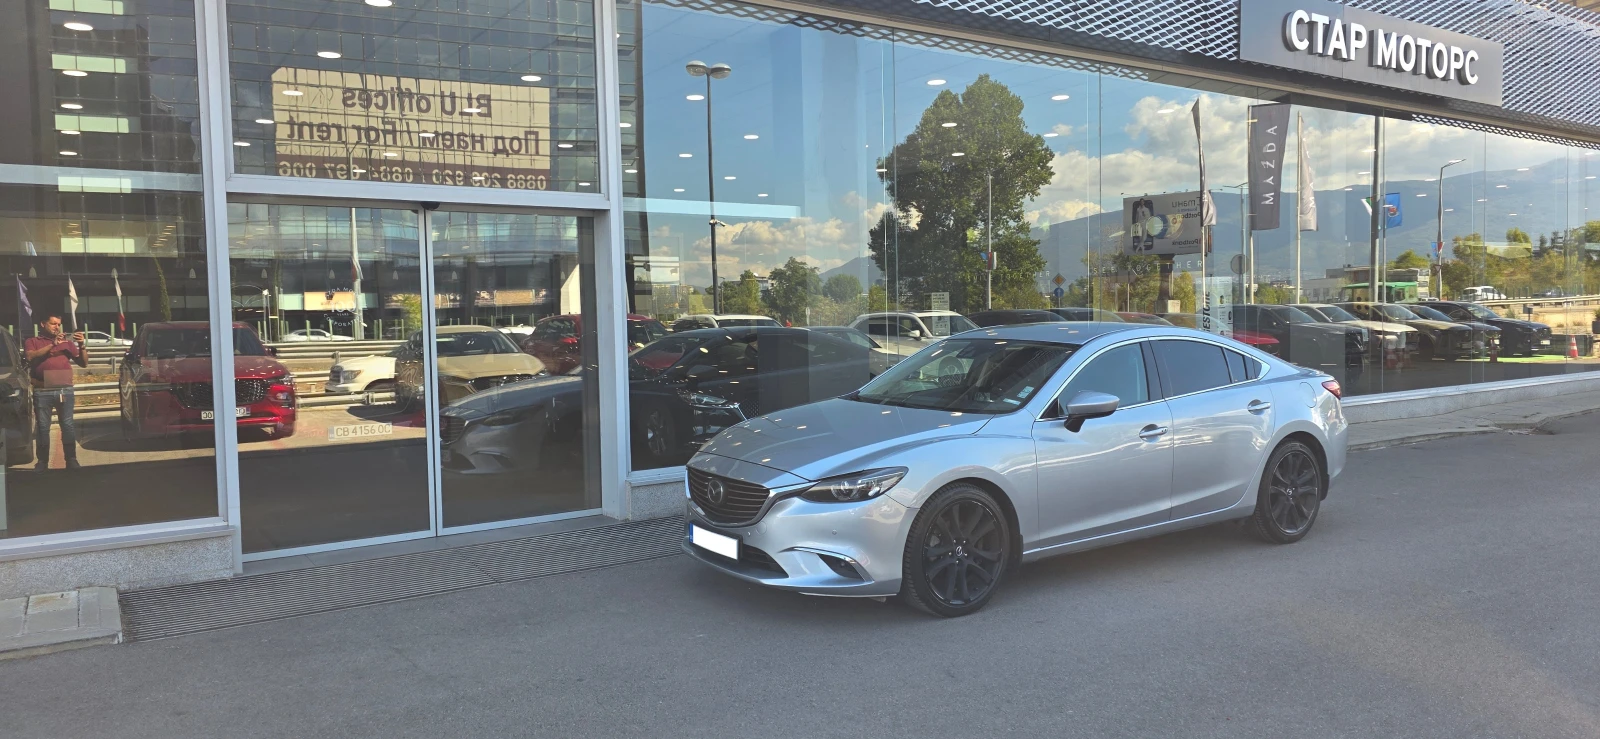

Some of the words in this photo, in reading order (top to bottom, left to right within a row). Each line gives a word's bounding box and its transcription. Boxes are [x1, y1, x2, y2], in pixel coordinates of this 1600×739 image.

[1284, 9, 1367, 61] СТАР
[1372, 28, 1479, 85] МОТОРС
[1260, 125, 1278, 205] MAZDA
[335, 425, 350, 437] CB
[352, 424, 376, 436] 4156
